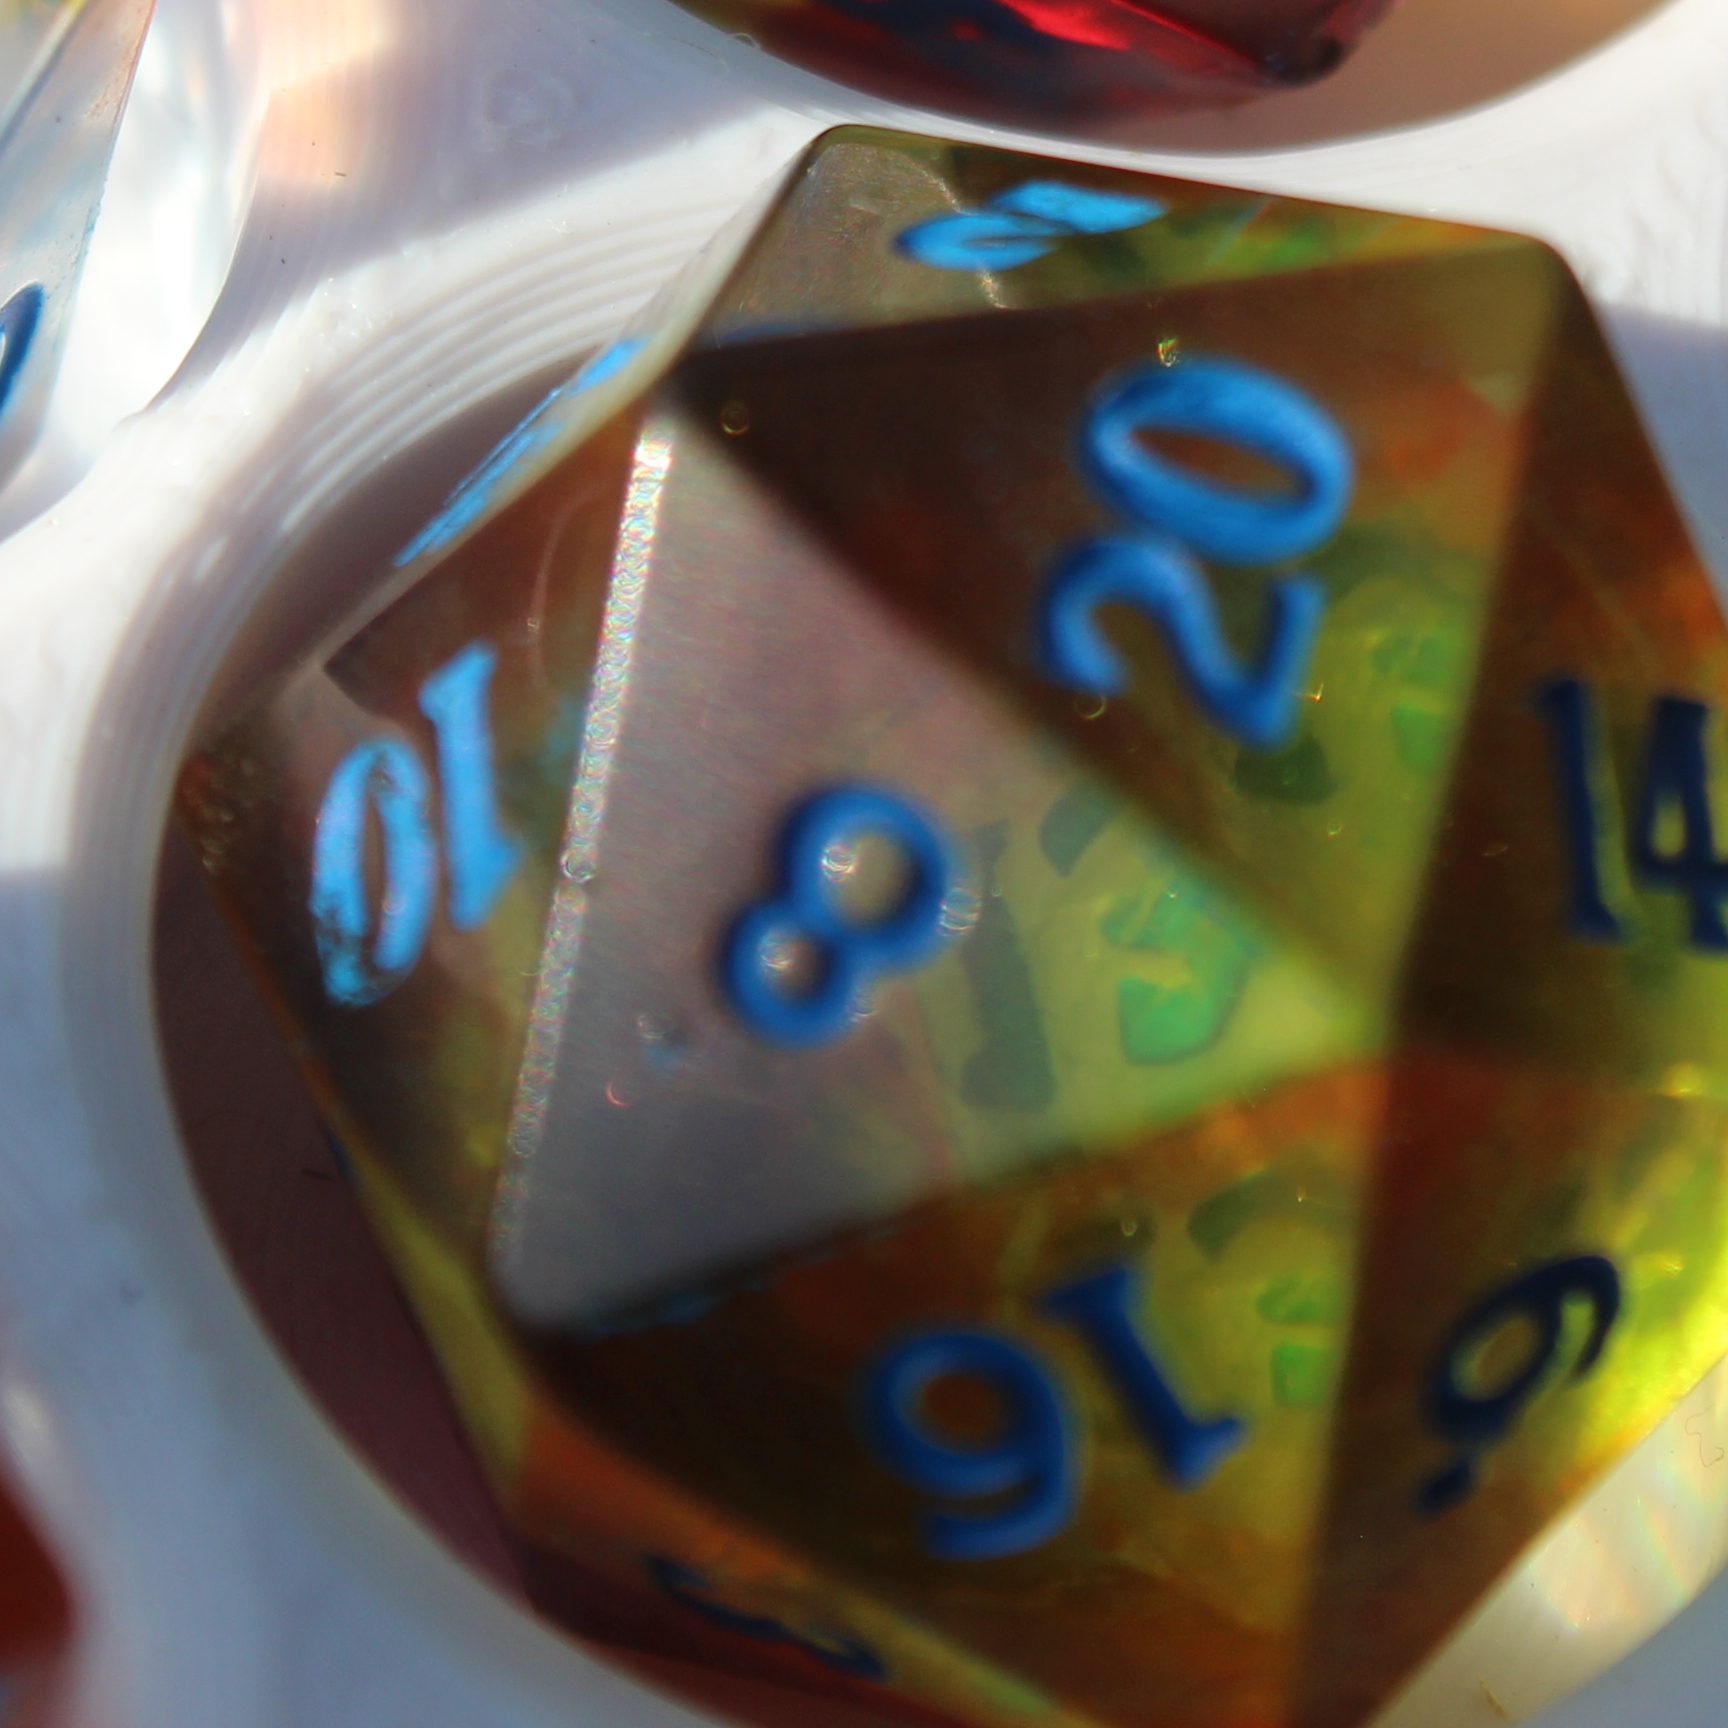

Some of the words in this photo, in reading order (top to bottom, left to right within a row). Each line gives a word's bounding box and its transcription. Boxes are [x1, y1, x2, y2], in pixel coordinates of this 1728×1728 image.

[1032, 354, 1357, 747] 20
[310, 640, 526, 1010] 10
[716, 784, 971, 1052] 8
[857, 1252, 1250, 1561] 16
